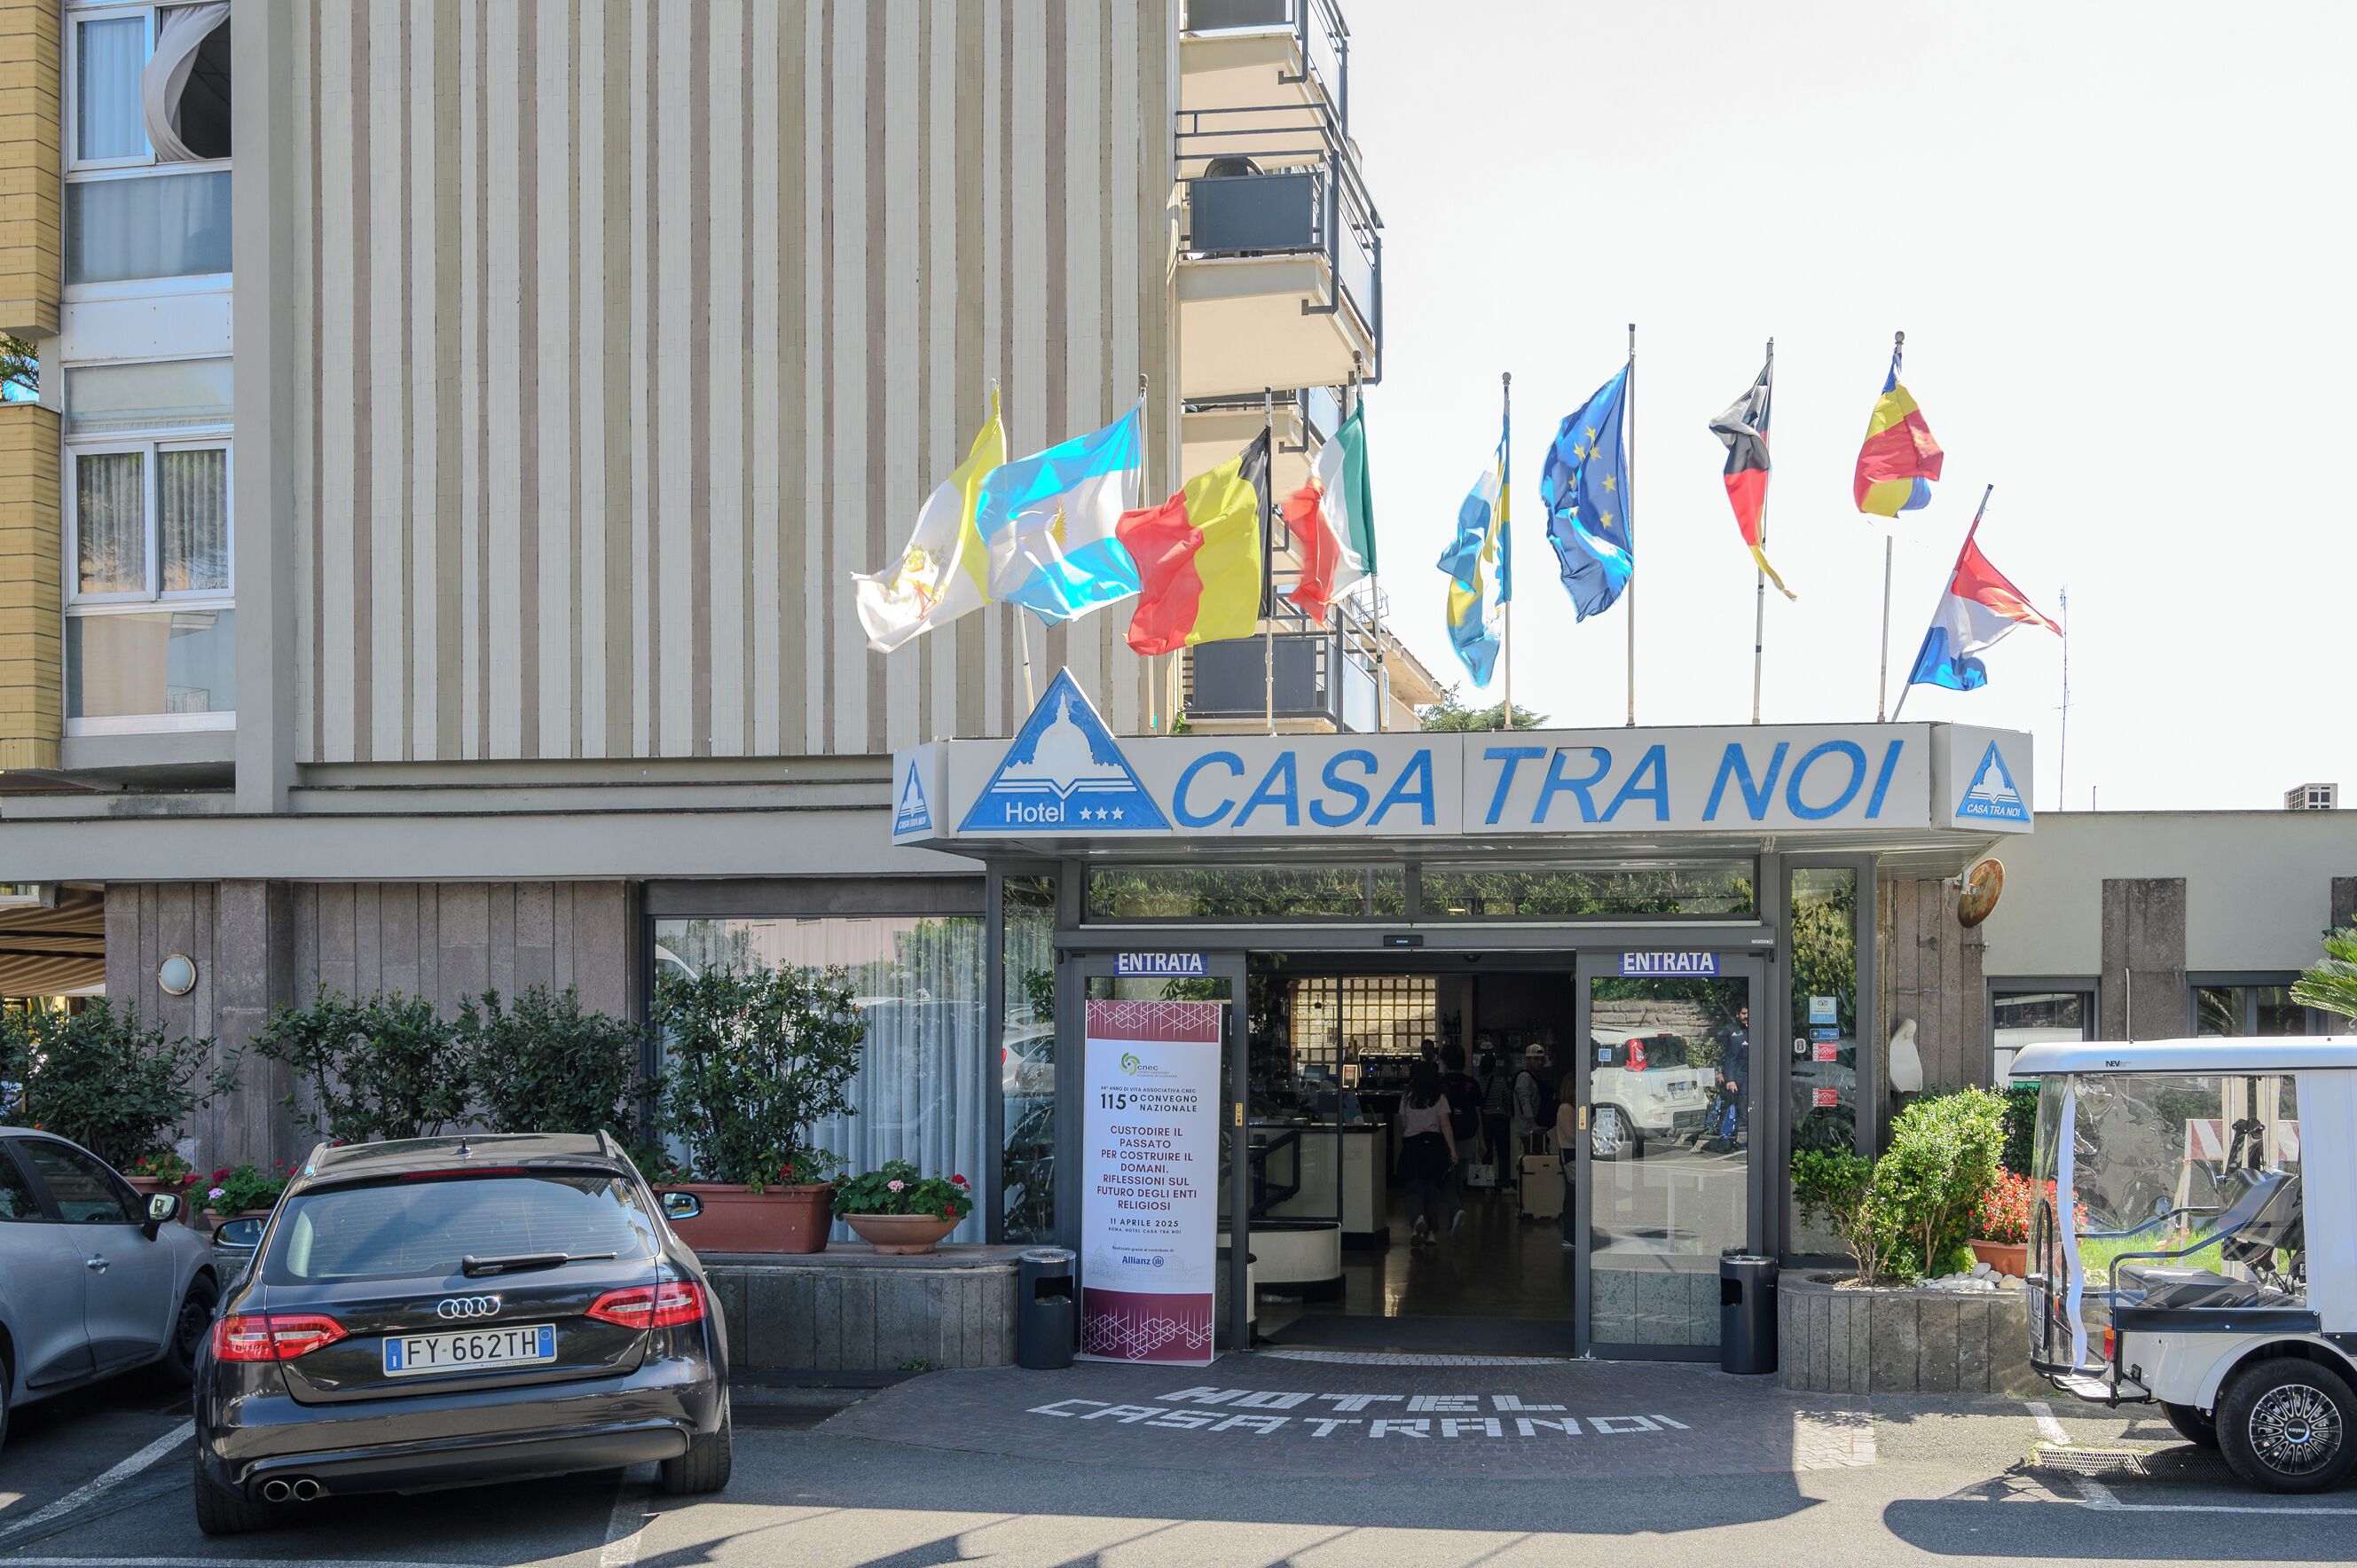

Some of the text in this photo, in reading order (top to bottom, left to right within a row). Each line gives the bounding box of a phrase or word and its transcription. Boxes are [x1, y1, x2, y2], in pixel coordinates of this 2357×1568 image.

[1173, 740, 1904, 827] CASA TRA NOI
[1005, 801, 1065, 822] Hotel
[1967, 804, 2021, 816] CASA TRA NOI
[1119, 953, 1203, 971] ENTRATA
[1623, 953, 1714, 972] ENTRATA
[1111, 1125, 1183, 1136] CUSTODIRE IL
[1120, 1139, 1171, 1149] PASSATO
[1101, 1149, 1117, 1158] PER
[1120, 1151, 1181, 1161] COSTRUIRE
[1120, 1163, 1169, 1173] DOMANI.
[1103, 1174, 1165, 1185] RIFLESSIONI
[1096, 1186, 1134, 1196] FUTURO
[1137, 1189, 1169, 1198] DEGLI
[1118, 1200, 1170, 1211] RELIGIOSI
[1121, 1256, 1151, 1266] Allianz
[407, 1338, 439, 1365] FY
[452, 1330, 536, 1361] 662TH
[1153, 1386, 1567, 1412] HOTEL
